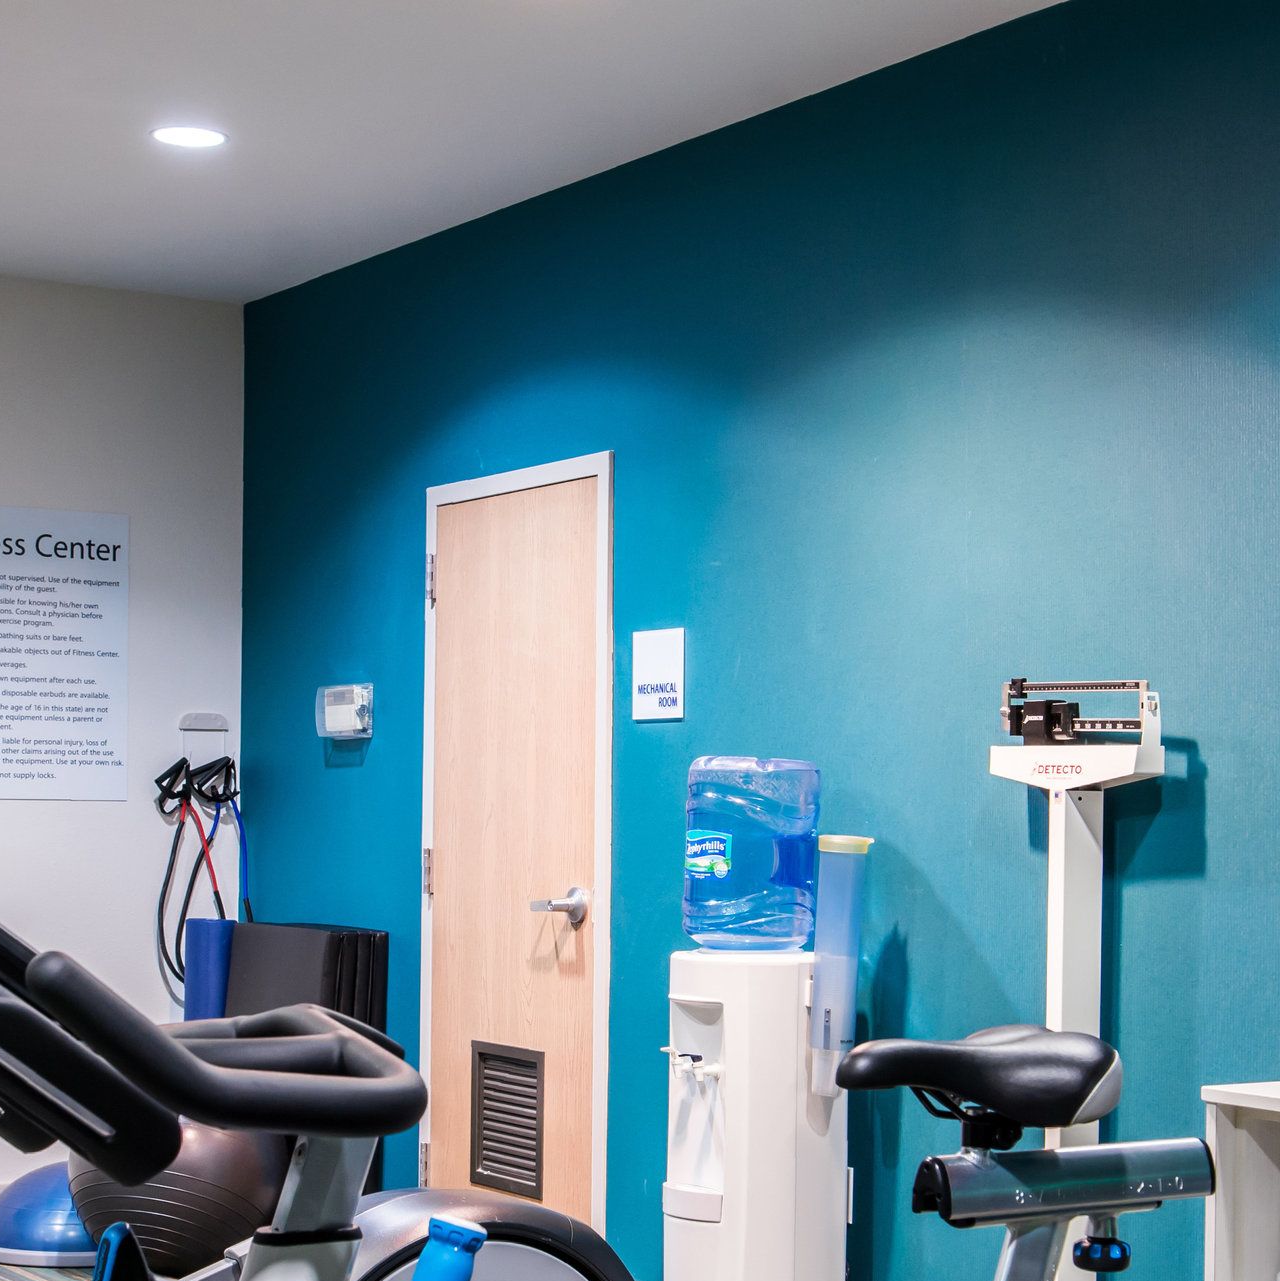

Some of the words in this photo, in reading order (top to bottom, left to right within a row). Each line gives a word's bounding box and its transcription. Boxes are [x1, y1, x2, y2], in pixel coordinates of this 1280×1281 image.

[35, 533, 121, 563] Center
[70, 577, 81, 585] the
[83, 579, 119, 588] equipment
[23, 584, 34, 592] the
[16, 598, 26, 606] for
[28, 599, 57, 609] knowing
[14, 608, 40, 616] Consult
[47, 610, 79, 620] physician
[23, 647, 49, 656] objects
[72, 649, 95, 657] Fitness
[10, 676, 47, 684] equipment
[638, 682, 677, 694] MECHANICAL
[1, 689, 37, 698] disposable
[39, 690, 66, 698] earbuds
[658, 696, 678, 707] ROOM
[64, 705, 83, 714] state)
[5, 714, 42, 722] equipment
[44, 714, 64, 722] unless
[72, 716, 93, 724] parent
[33, 738, 62, 747] personal
[43, 748, 66, 757] arising
[1038, 765, 1082, 774] DETECTO
[12, 772, 35, 780] supply
